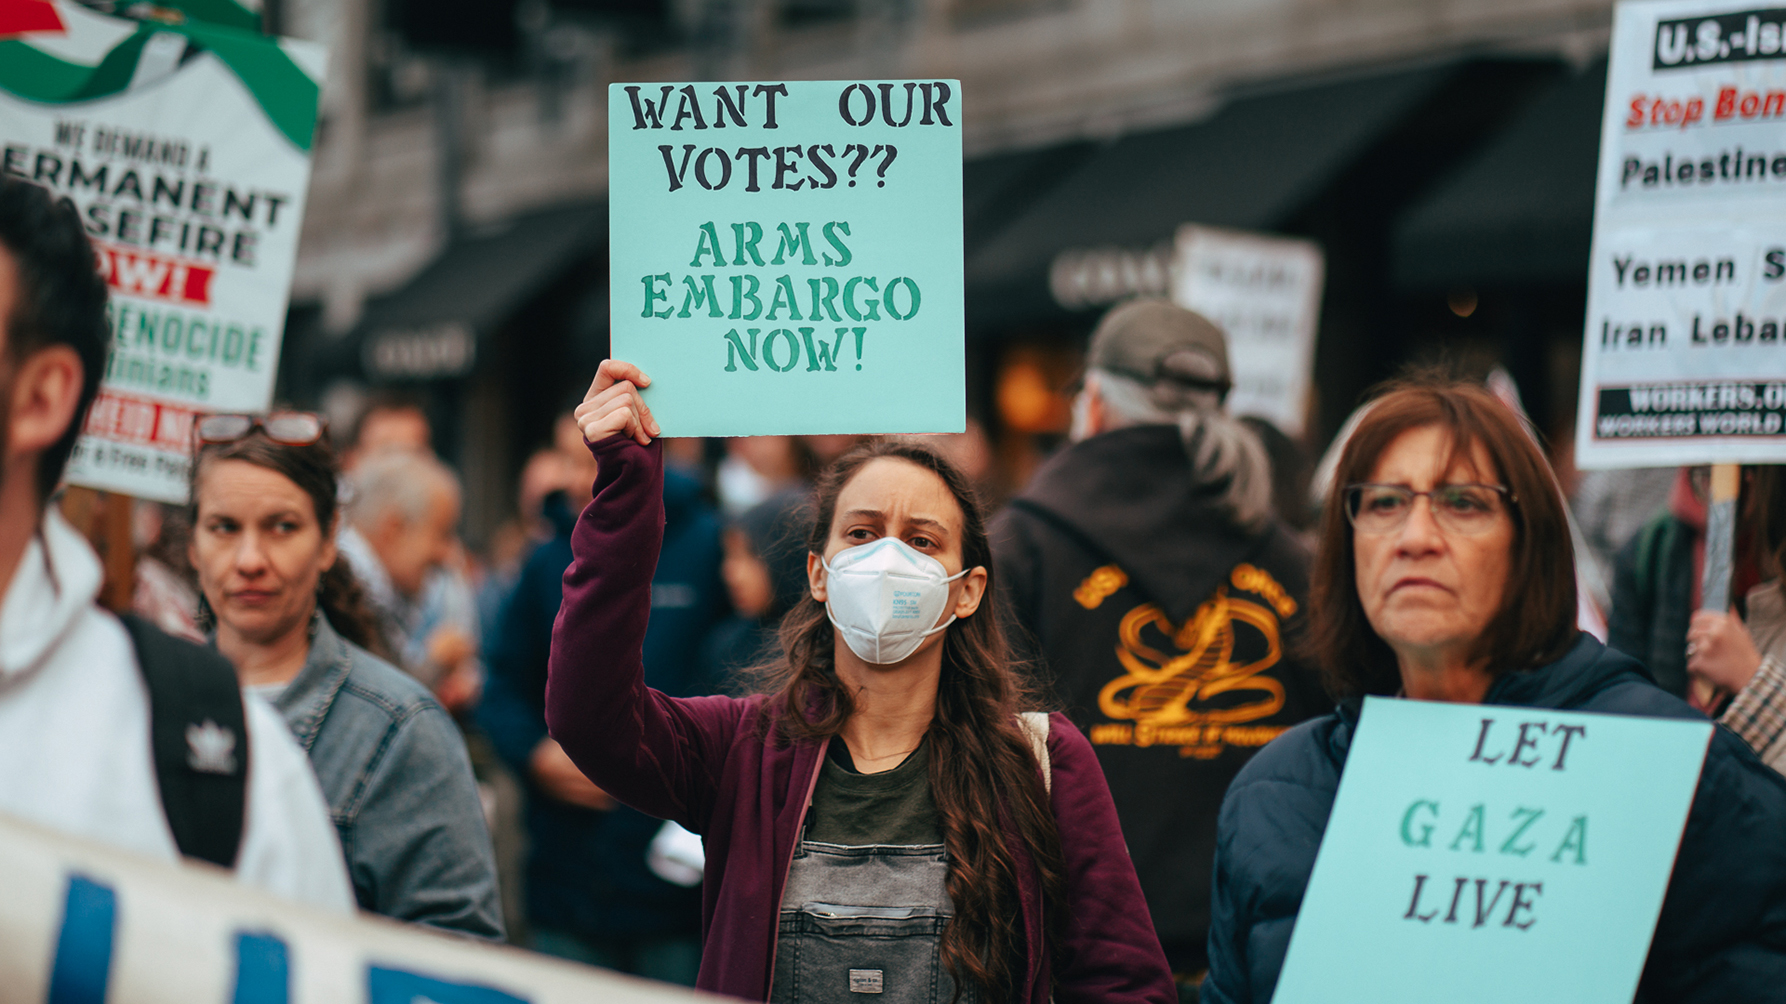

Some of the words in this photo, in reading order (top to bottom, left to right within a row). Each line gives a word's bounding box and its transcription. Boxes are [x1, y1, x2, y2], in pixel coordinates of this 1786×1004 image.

[624, 83, 789, 131] WANT
[838, 81, 953, 128] OUR
[1625, 93, 1705, 132] Stop
[54, 119, 87, 149] WE
[92, 126, 190, 169] DEMAND
[195, 144, 211, 173] A
[657, 143, 898, 193] VOTES??
[1620, 146, 1786, 190] Palestine
[689, 220, 853, 268] ARMS
[640, 272, 922, 323] EMBARGO
[1612, 256, 1736, 290] Yemen
[723, 326, 868, 373] NOW!
[1600, 318, 1667, 348] Iran
[1597, 412, 1697, 438] WORKERS
[1699, 410, 1783, 435] WORLD
[1469, 718, 1586, 770] LET
[1400, 800, 1590, 865] GAZA
[1403, 875, 1543, 931] LIVE
